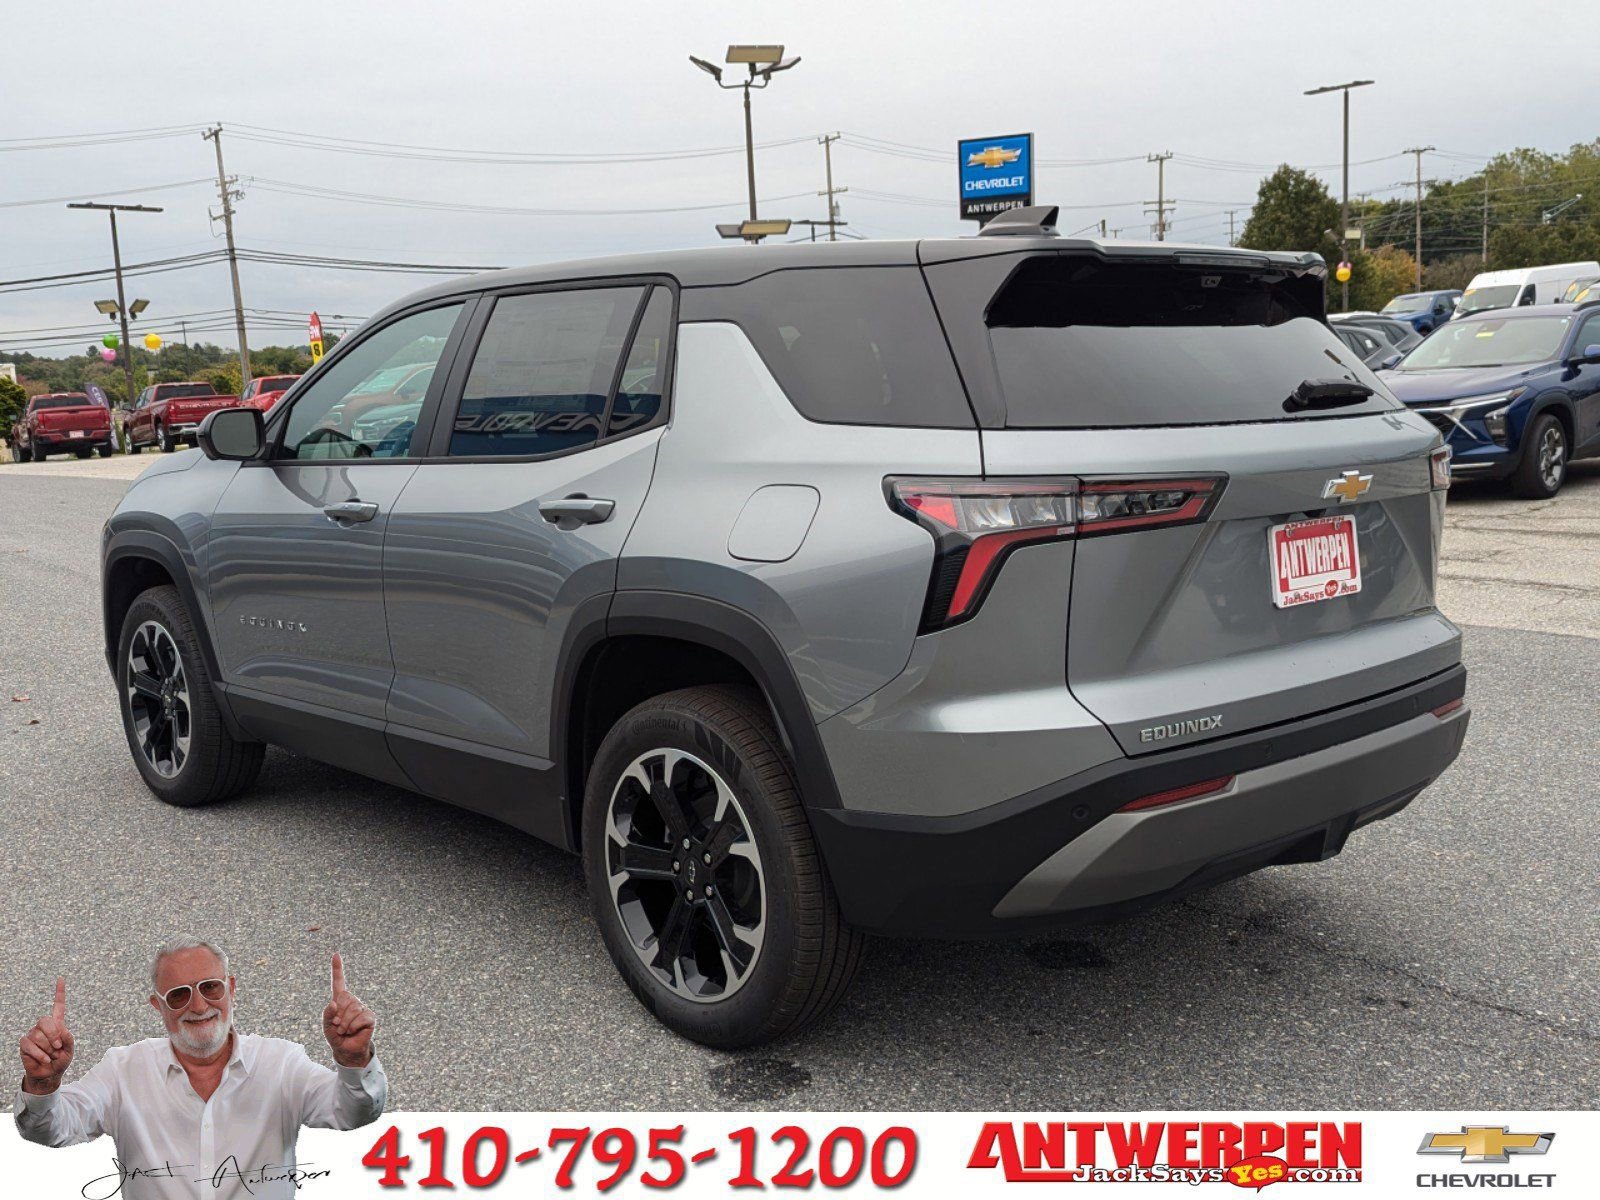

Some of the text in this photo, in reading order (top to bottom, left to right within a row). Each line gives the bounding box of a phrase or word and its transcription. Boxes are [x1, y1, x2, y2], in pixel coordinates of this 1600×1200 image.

[965, 176, 1024, 191] CHEVROLET
[967, 201, 1024, 214] ANTWERPEN
[1280, 532, 1351, 579] ANTWERPEN
[239, 614, 307, 632] EQUINOX
[1140, 714, 1223, 743] EQUINOX
